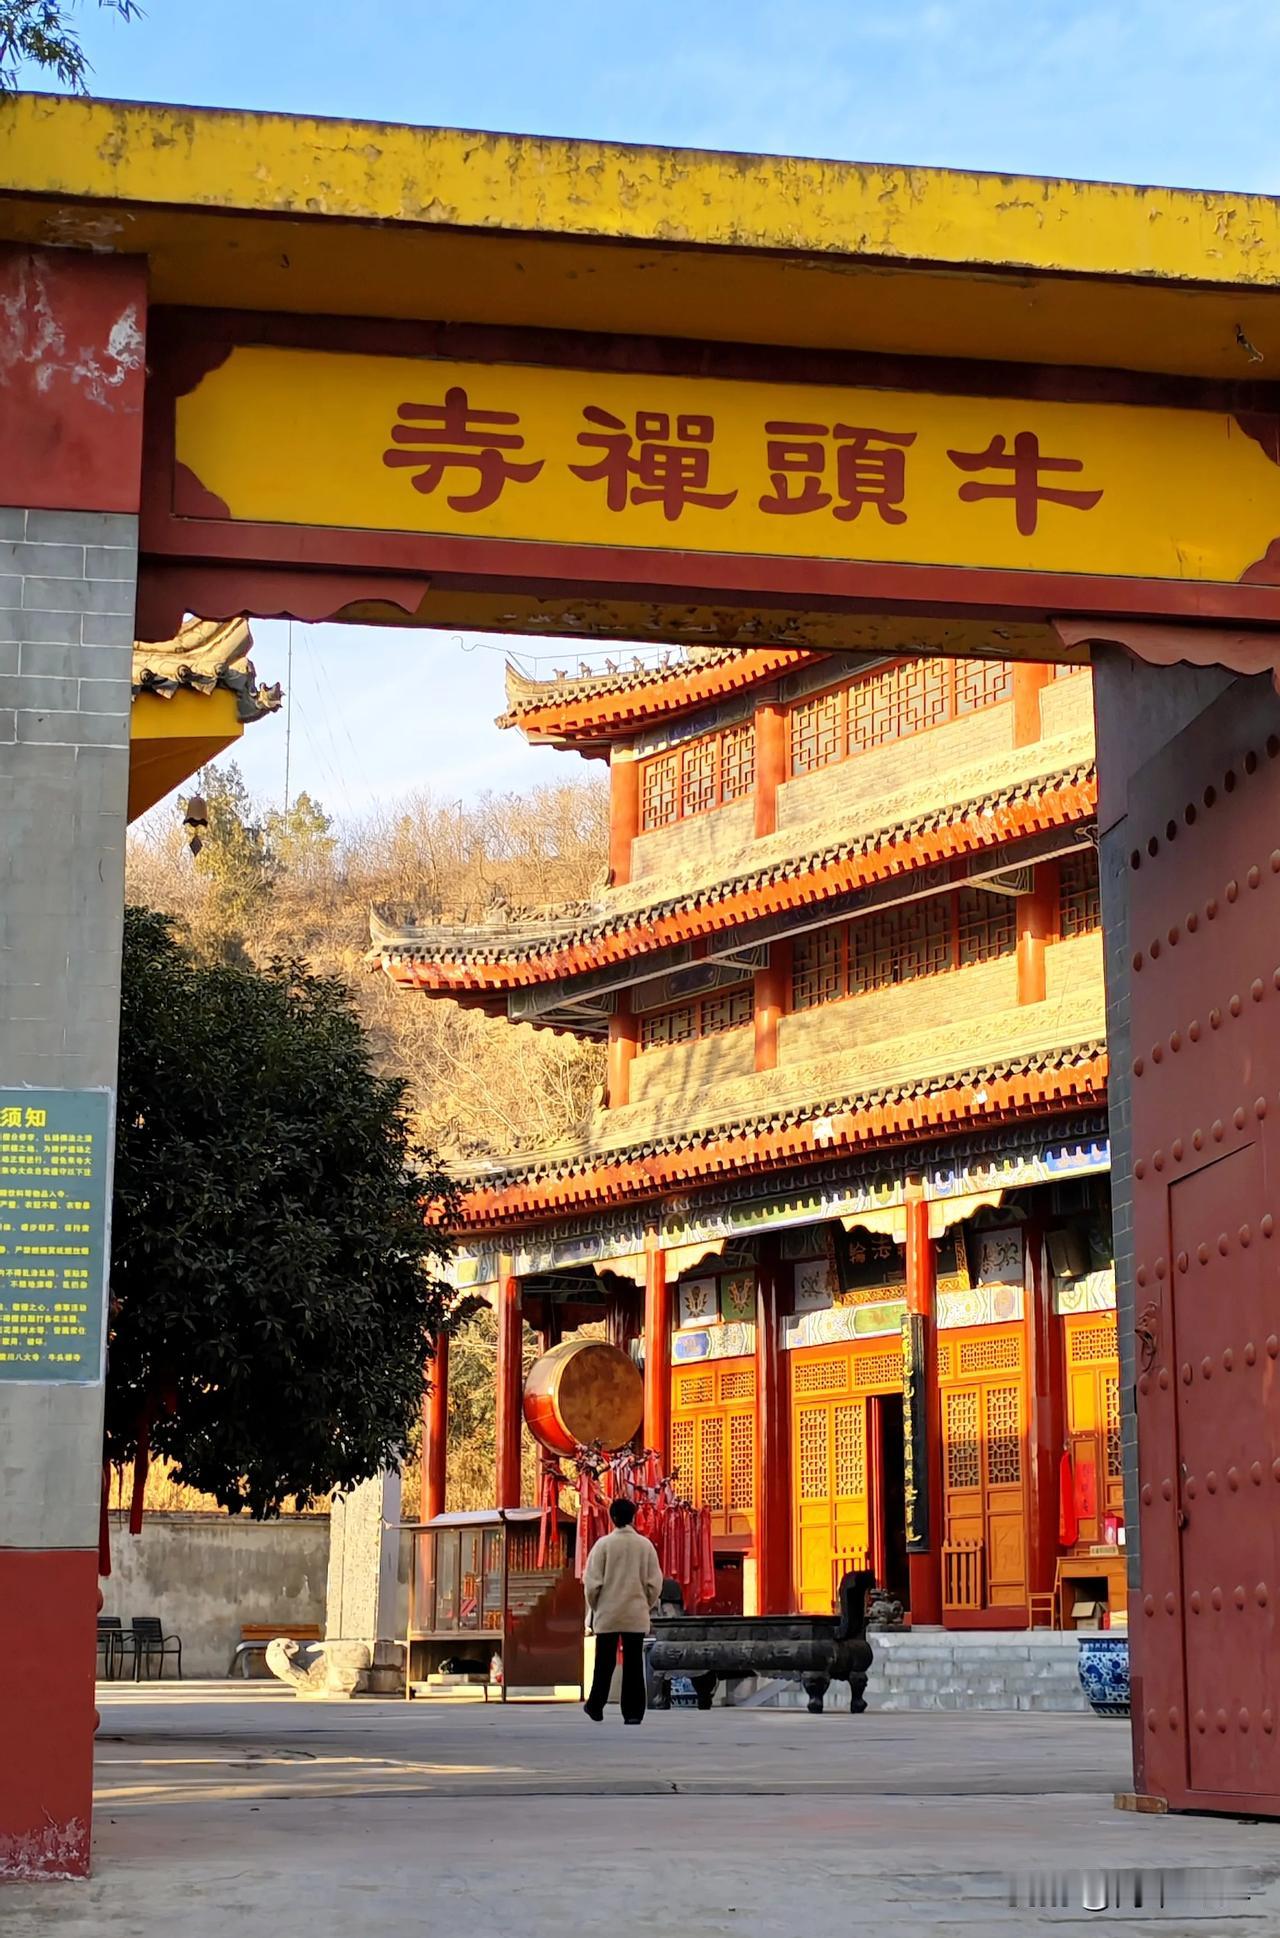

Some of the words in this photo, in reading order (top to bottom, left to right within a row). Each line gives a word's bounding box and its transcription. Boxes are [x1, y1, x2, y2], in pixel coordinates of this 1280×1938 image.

[382, 386, 1104, 536] 牛頭禪寺
[0, 1107, 46, 1128] 须知
